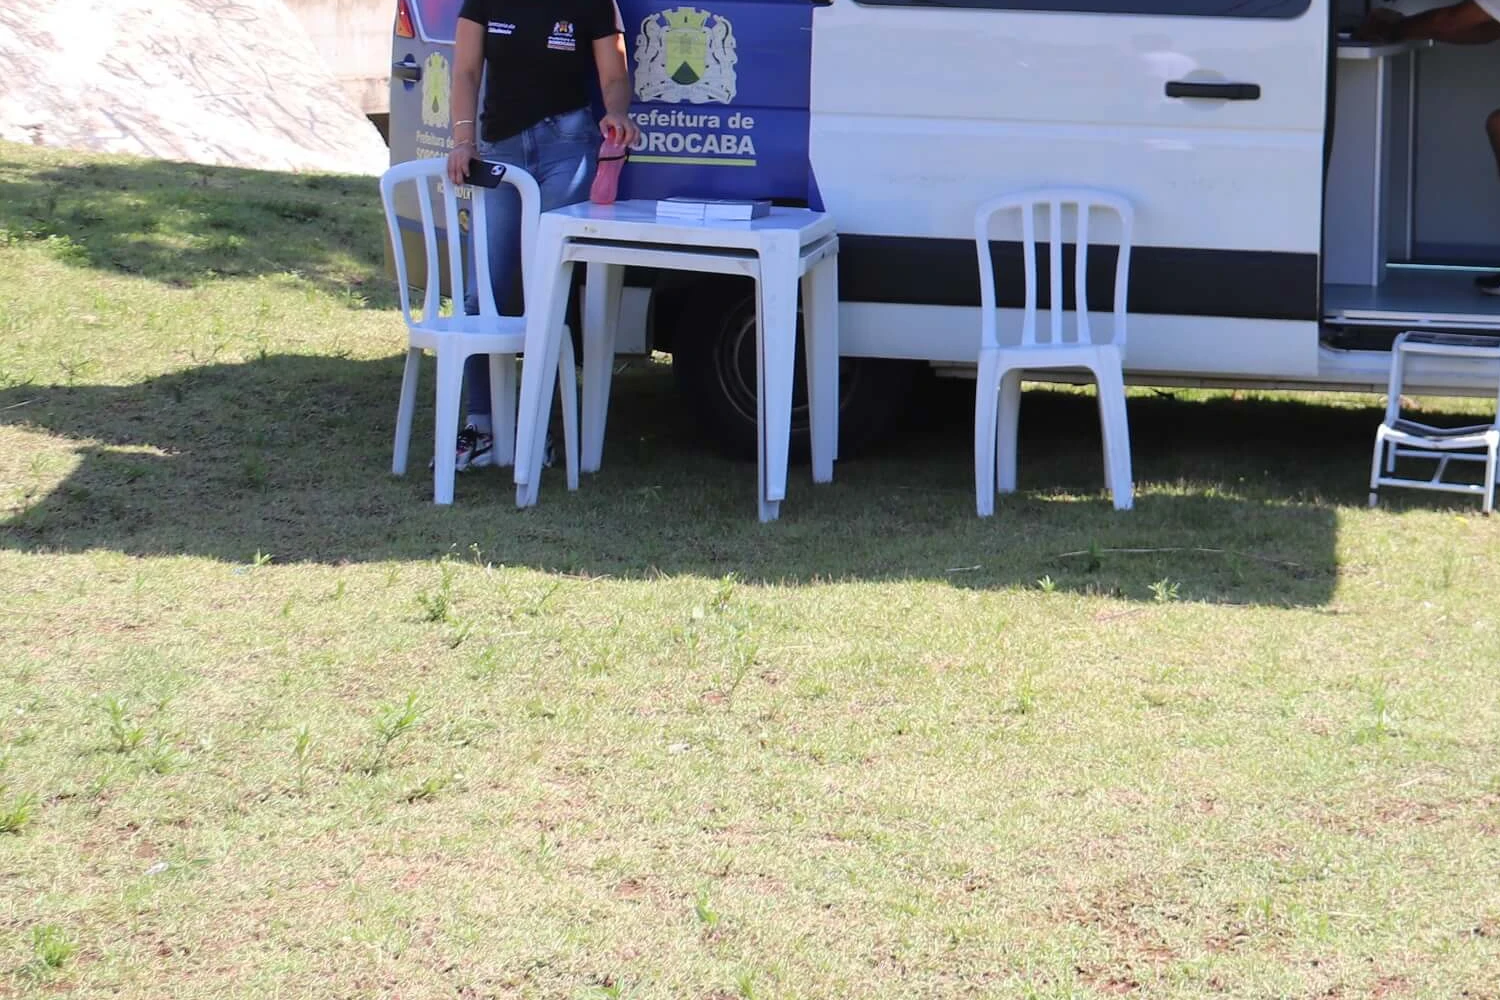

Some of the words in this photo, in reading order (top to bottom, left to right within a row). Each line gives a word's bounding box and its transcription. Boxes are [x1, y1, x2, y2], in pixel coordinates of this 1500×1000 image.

[629, 109, 720, 129] refeitura
[727, 112, 755, 130] de
[628, 132, 756, 156] OROCABA
